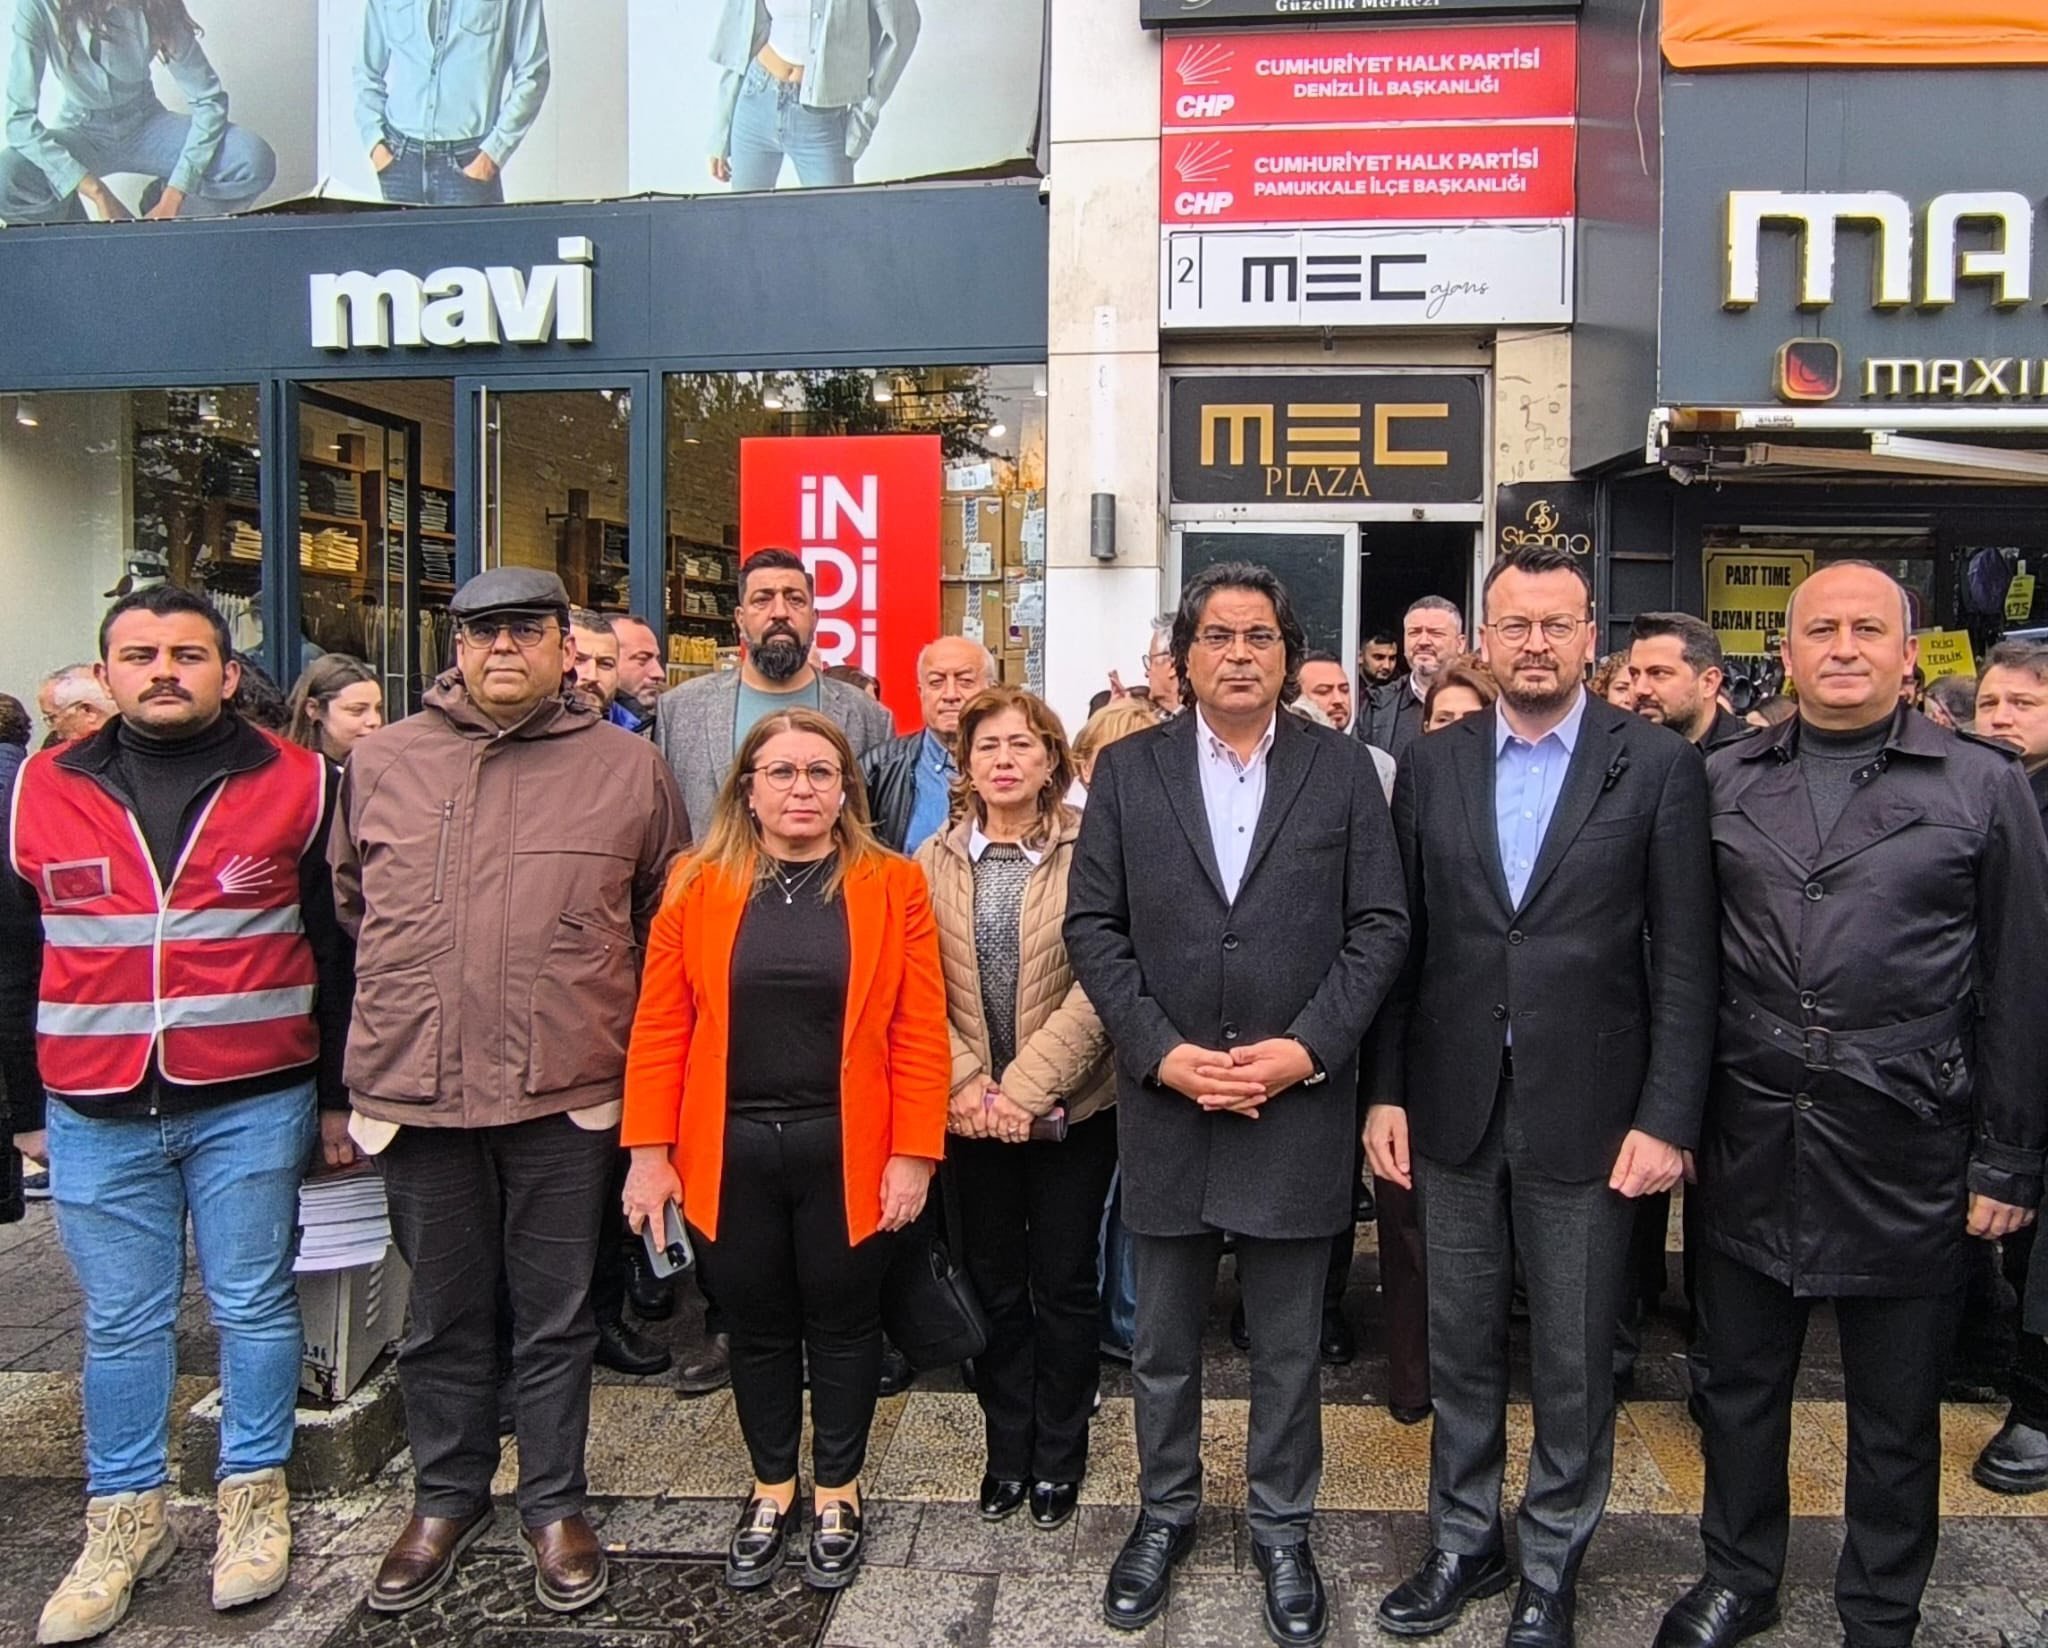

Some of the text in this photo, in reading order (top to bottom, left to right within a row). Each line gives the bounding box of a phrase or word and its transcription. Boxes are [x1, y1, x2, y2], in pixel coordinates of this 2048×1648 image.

[1255, 47, 1540, 76] CUMHURİYET HALK PARTİSİ
[1293, 75, 1499, 98] DENİZLİ İL BAŞKANLIĞI
[1176, 94, 1236, 118] CHP
[1253, 147, 1539, 174] CUMHURİYET HALK PARTİSİ
[1253, 173, 1527, 197] PAMUKKALE İLÇE BAŞKANLIĞI
[1173, 191, 1234, 216] CHP
[1177, 256, 1195, 284] 2
[1242, 254, 1427, 302] MEC
[309, 236, 594, 351] mavi
[1862, 357, 2048, 397] MAXI
[1200, 403, 1449, 466] MEC
[1264, 466, 1372, 497] PLAZA
[1725, 564, 1791, 587] PART TIME
[1711, 609, 1752, 630] BAYAN
